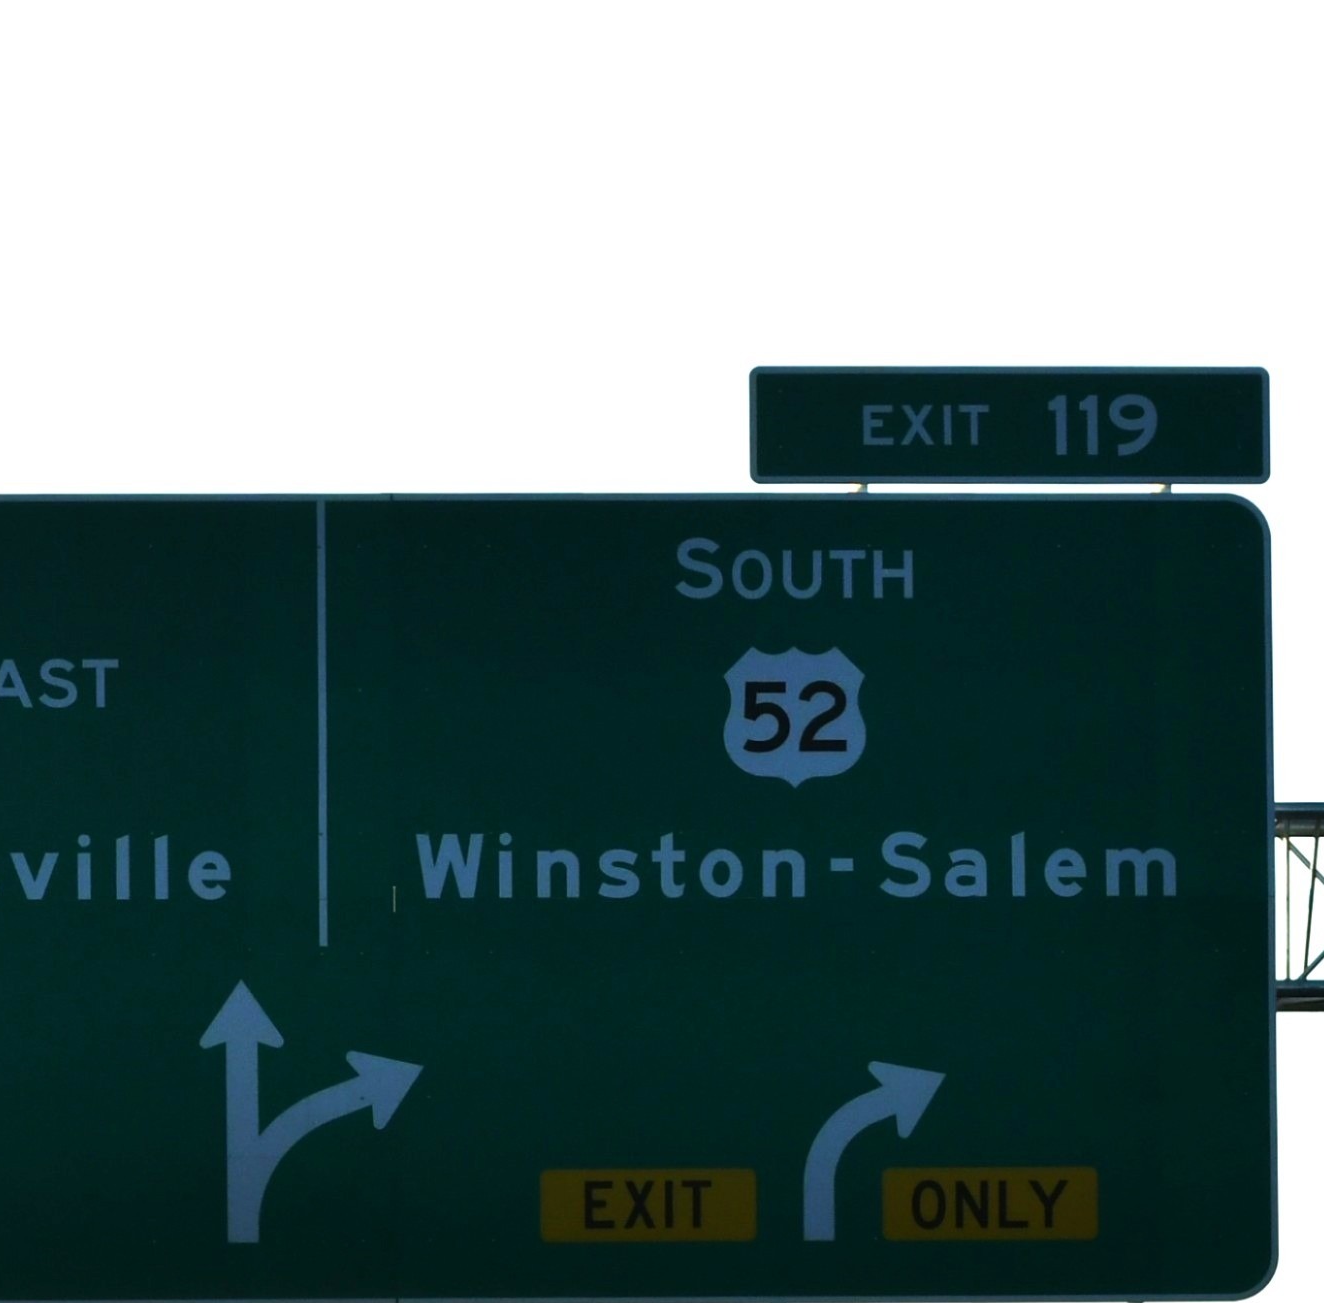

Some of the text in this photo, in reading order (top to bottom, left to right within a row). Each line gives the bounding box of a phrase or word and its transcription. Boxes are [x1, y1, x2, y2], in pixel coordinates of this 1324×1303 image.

[862, 393, 1158, 456] EXIT 119
[675, 537, 914, 600] SOUTH
[743, 680, 848, 753] 52
[415, 831, 1178, 899] Winston-Salem
[583, 1180, 1069, 1230] EXIT ONLY
